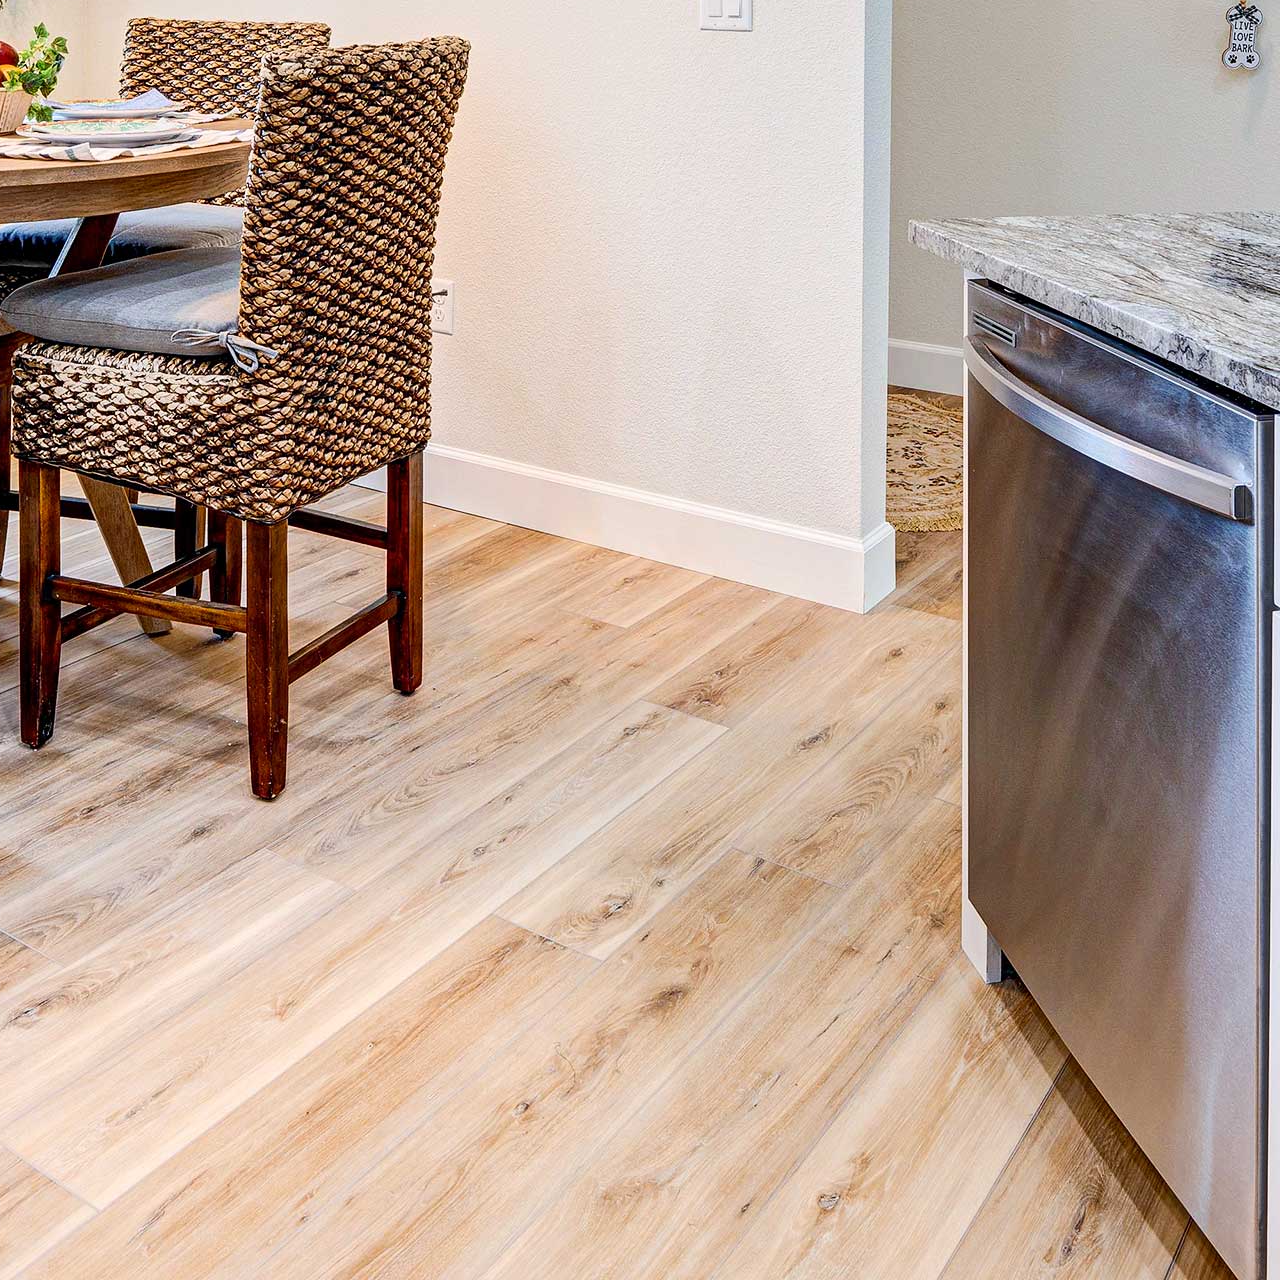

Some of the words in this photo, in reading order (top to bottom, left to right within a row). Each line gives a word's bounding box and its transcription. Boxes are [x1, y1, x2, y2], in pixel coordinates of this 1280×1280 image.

[1234, 21, 1254, 31] LIVE
[1233, 32, 1254, 42] LOVE
[1231, 42, 1253, 53] BARK
